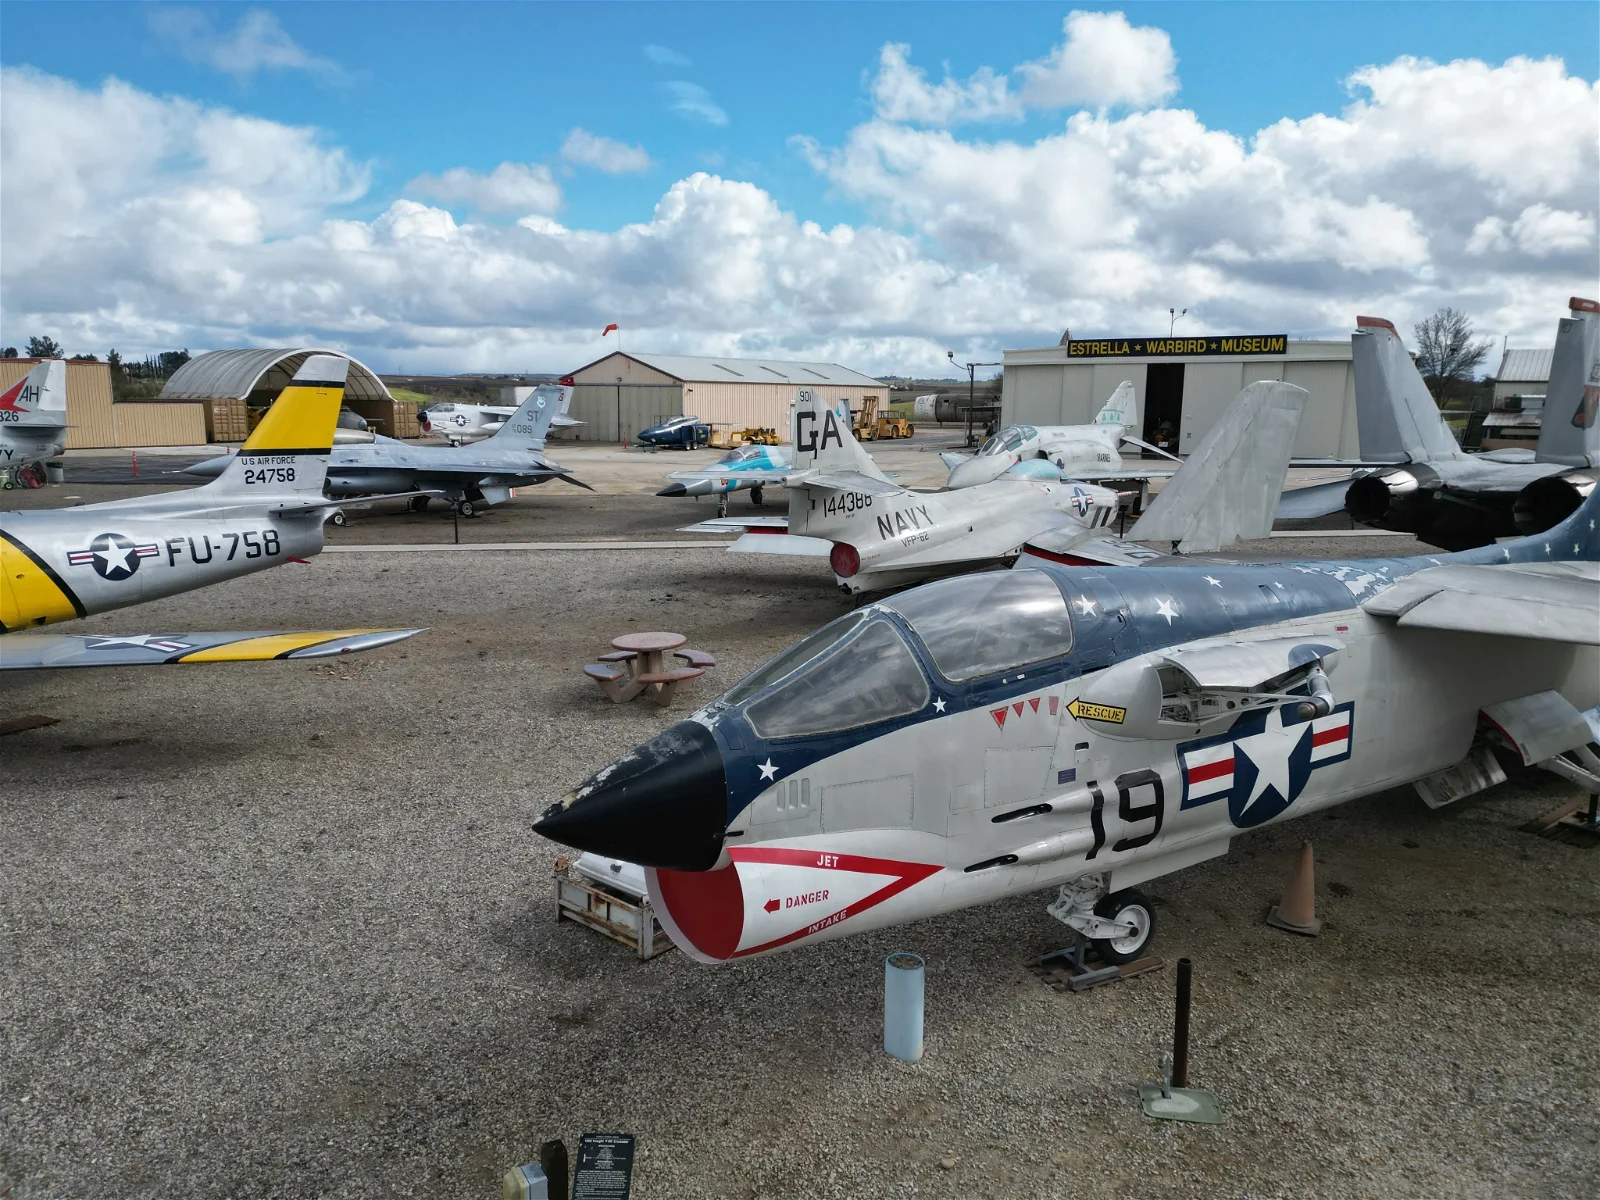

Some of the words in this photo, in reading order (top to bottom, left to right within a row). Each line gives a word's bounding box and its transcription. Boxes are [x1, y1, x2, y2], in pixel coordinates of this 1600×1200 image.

[1070, 341, 1130, 355] ESTRELLA
[1146, 339, 1207, 354] WARBIRD
[1221, 337, 1284, 352] MUSEUM
[19, 385, 39, 402] AH
[800, 391, 811, 402] 901
[527, 410, 539, 423] ST
[517, 424, 532, 434] 089
[796, 409, 843, 455] GA
[257, 457, 270, 465] AIR
[271, 456, 296, 465] FORCE
[244, 467, 296, 485] 24758
[876, 505, 934, 540] NAVY
[166, 529, 281, 567] FU-758
[901, 531, 930, 548] VFP-62
[1077, 704, 1123, 721] RESCUE
[1085, 769, 1165, 861] 19
[816, 854, 840, 868] JET
[785, 889, 830, 909] DANGER
[808, 909, 848, 934] INTAKE
